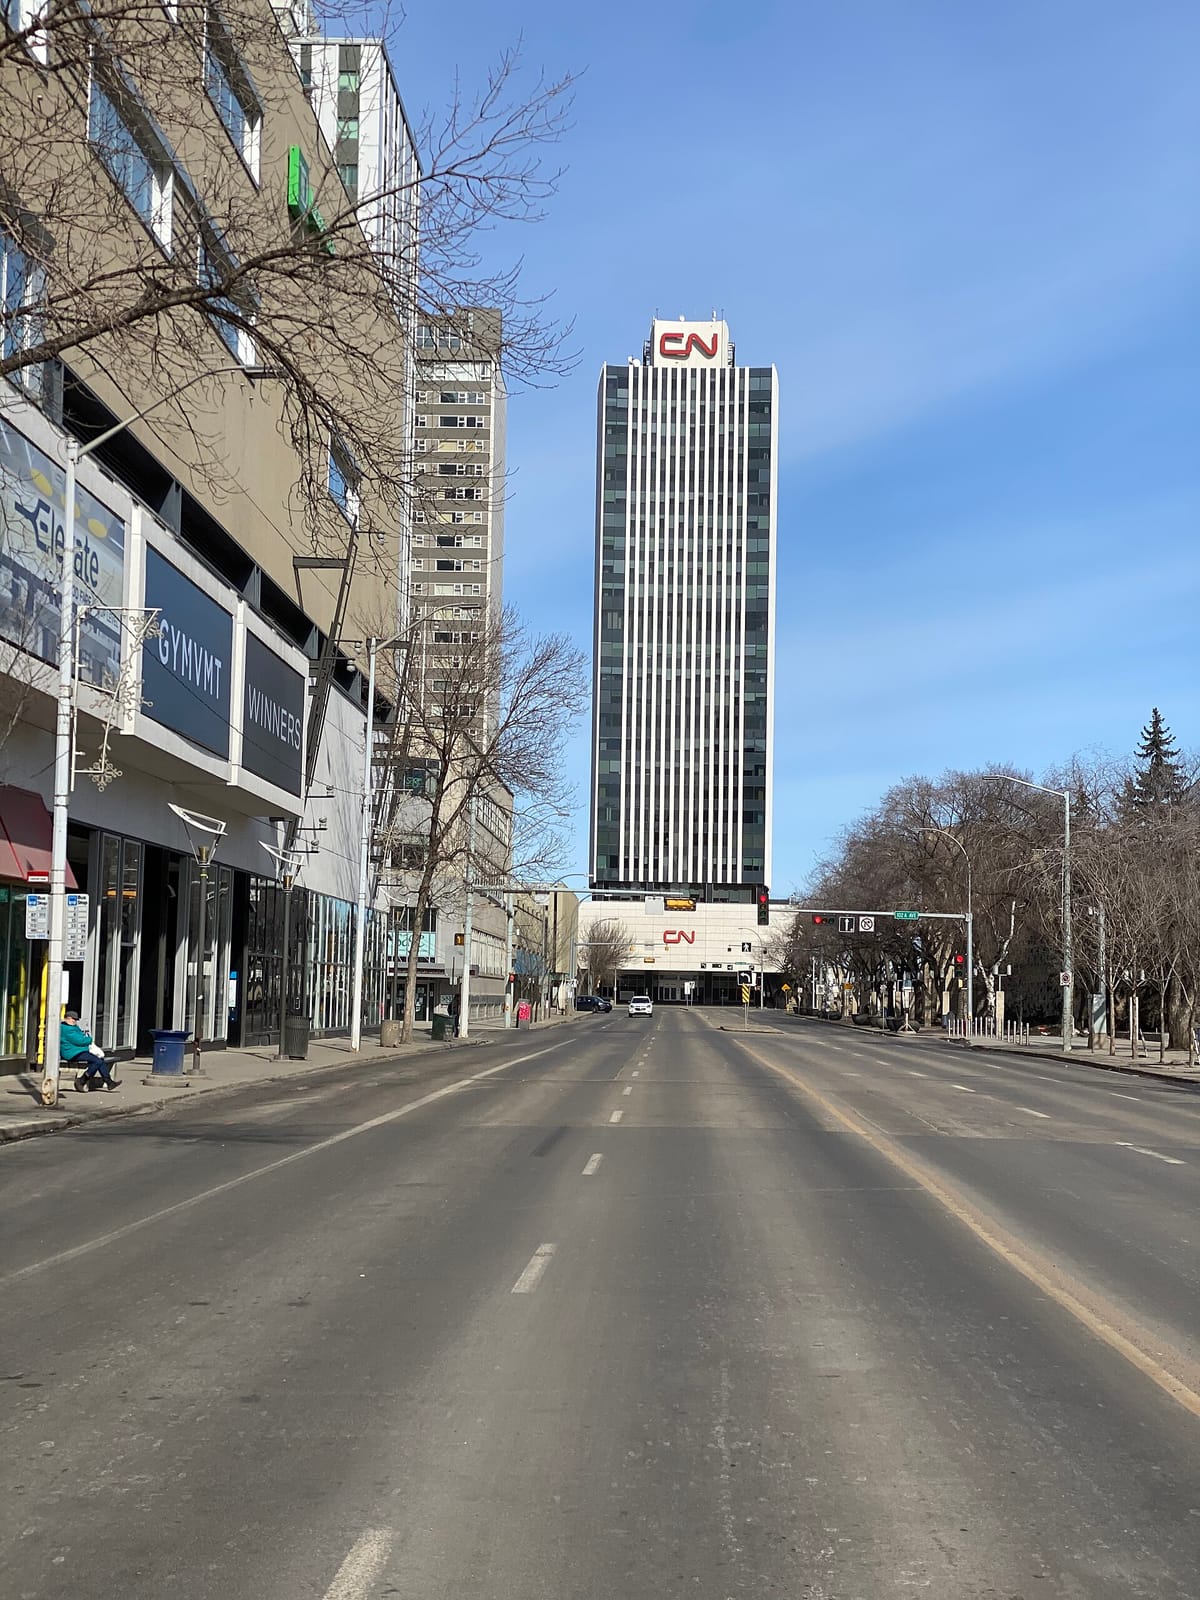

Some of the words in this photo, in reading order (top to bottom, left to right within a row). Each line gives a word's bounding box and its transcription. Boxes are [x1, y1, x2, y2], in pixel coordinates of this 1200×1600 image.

[660, 333, 718, 356] CN
[15, 498, 99, 588] Eleate
[158, 618, 222, 700] GYMVMT
[248, 683, 301, 750] WINNERS
[663, 930, 695, 944] CN
